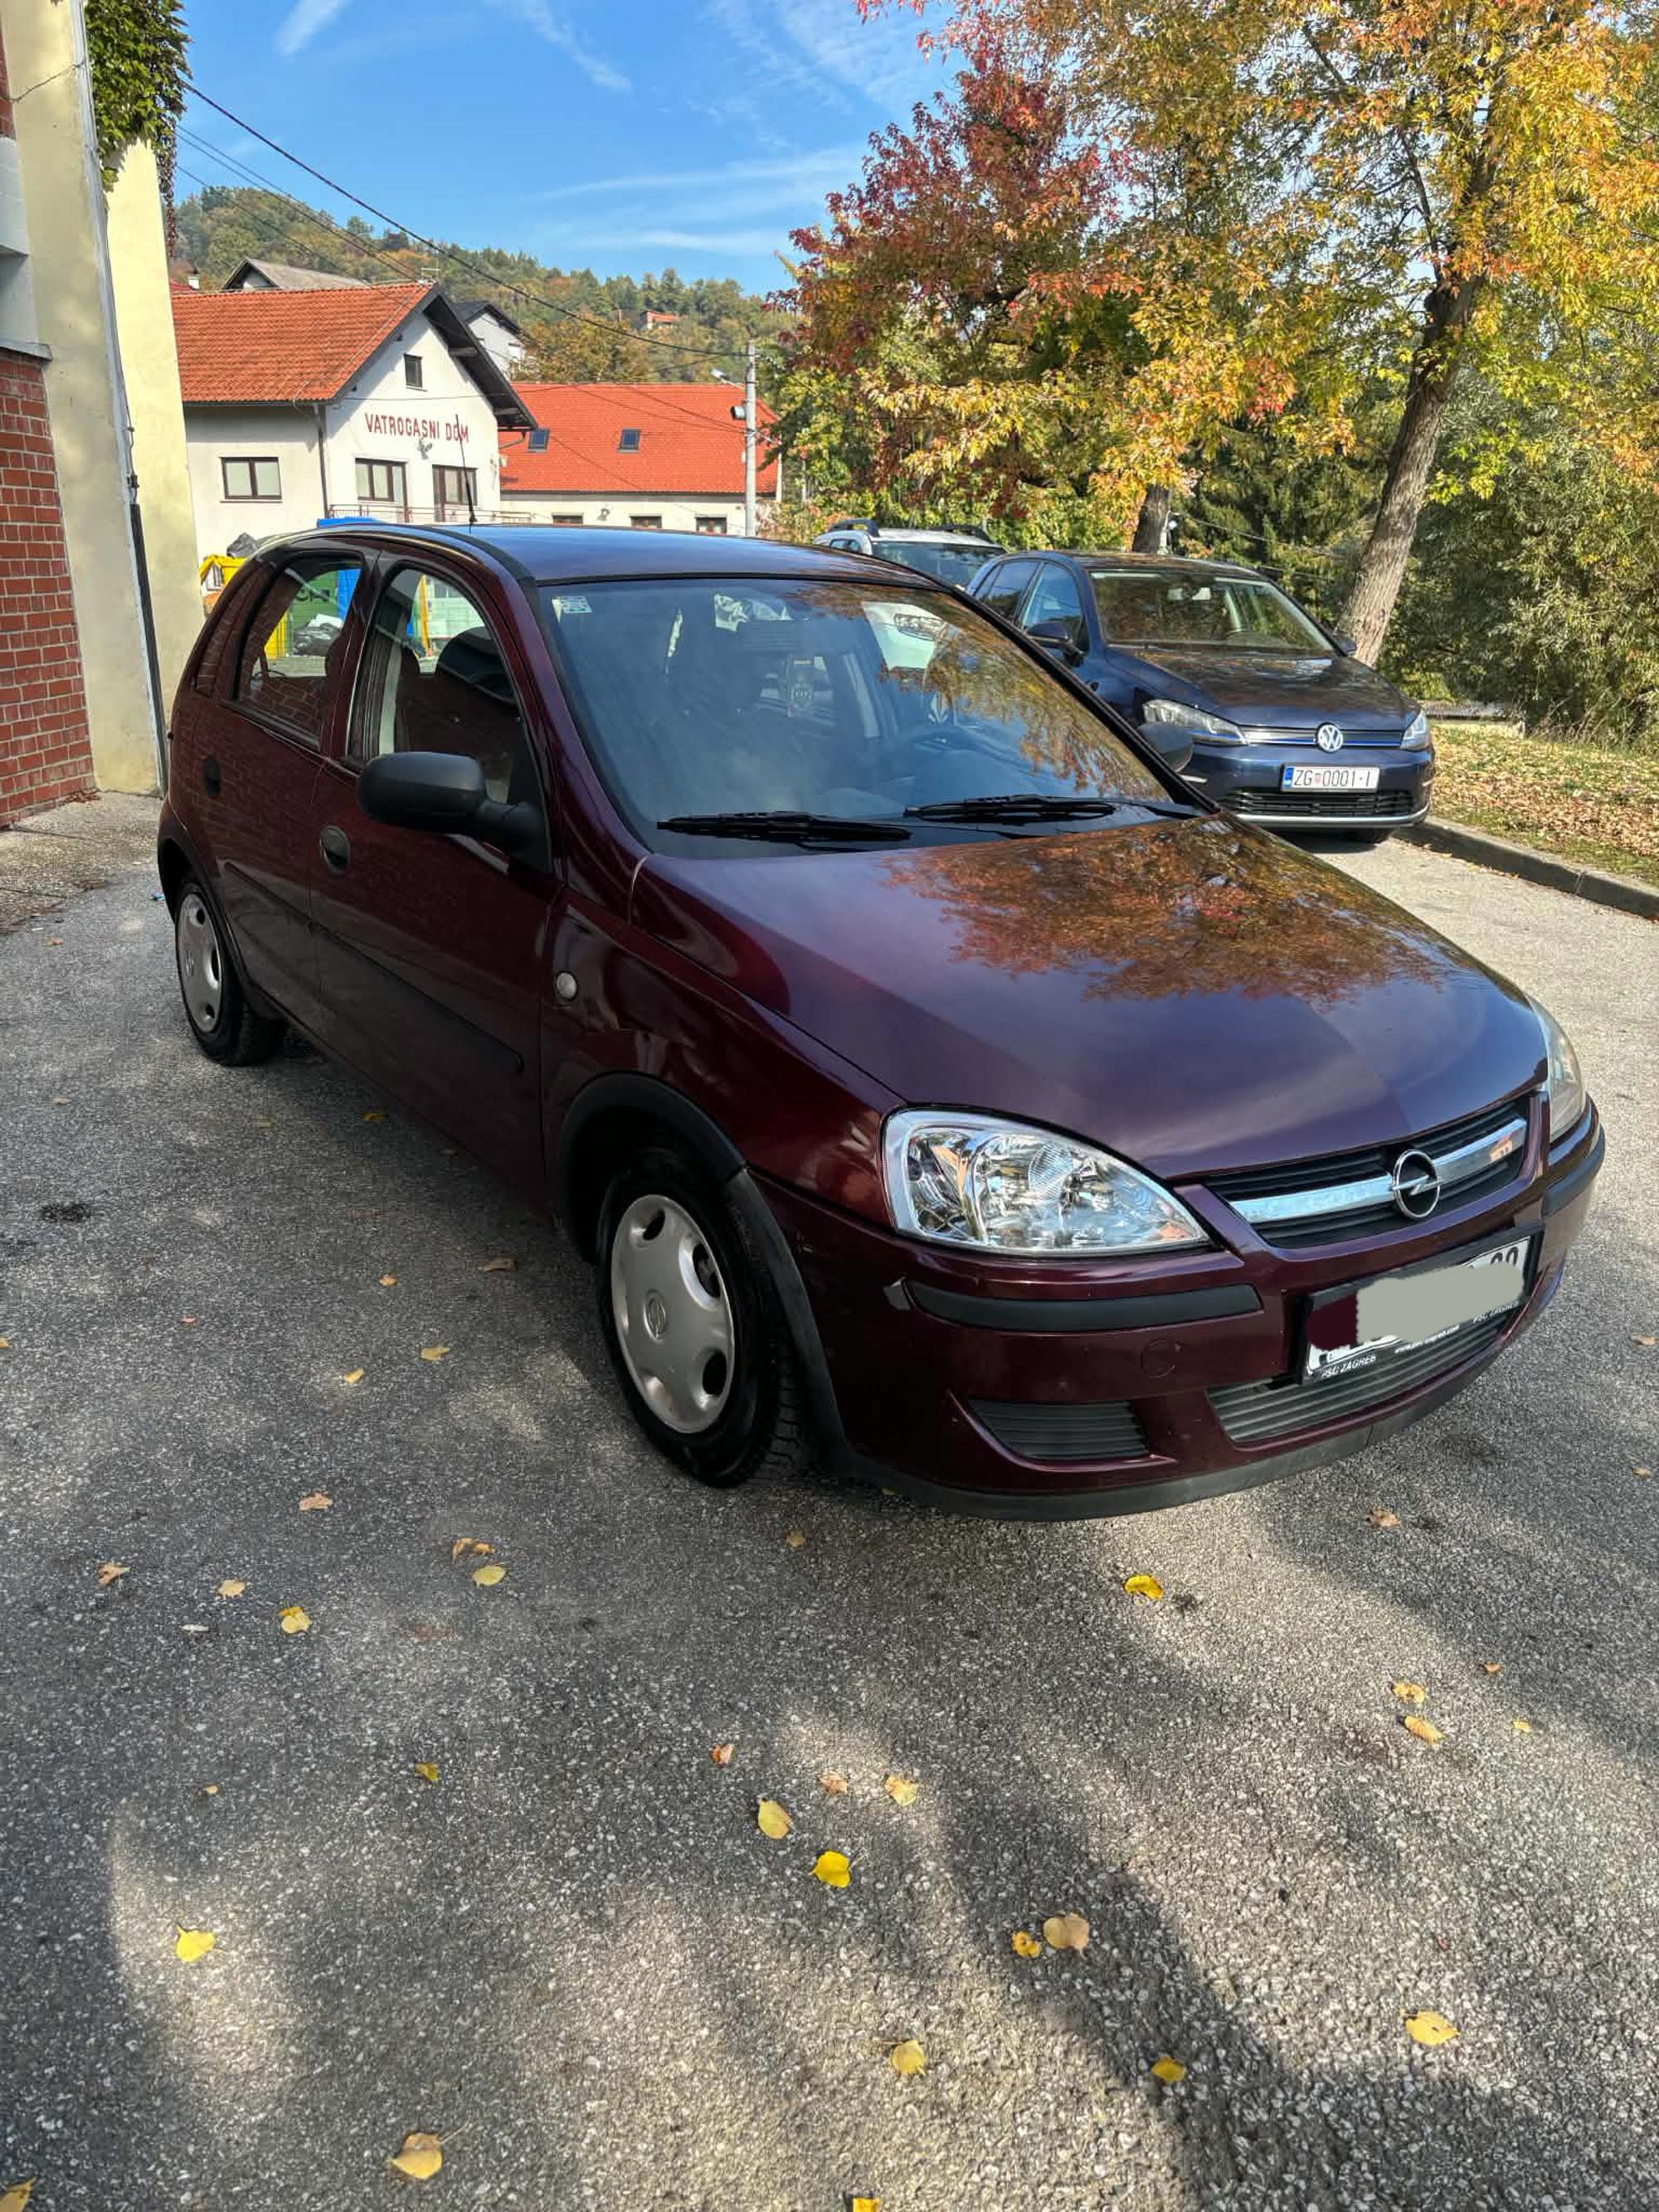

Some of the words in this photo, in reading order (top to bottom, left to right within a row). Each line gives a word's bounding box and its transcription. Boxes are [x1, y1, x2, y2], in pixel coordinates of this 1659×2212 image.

[365, 413, 440, 440] VATROGASNI
[445, 422, 469, 443] DOM
[1294, 770, 1313, 786] ZG
